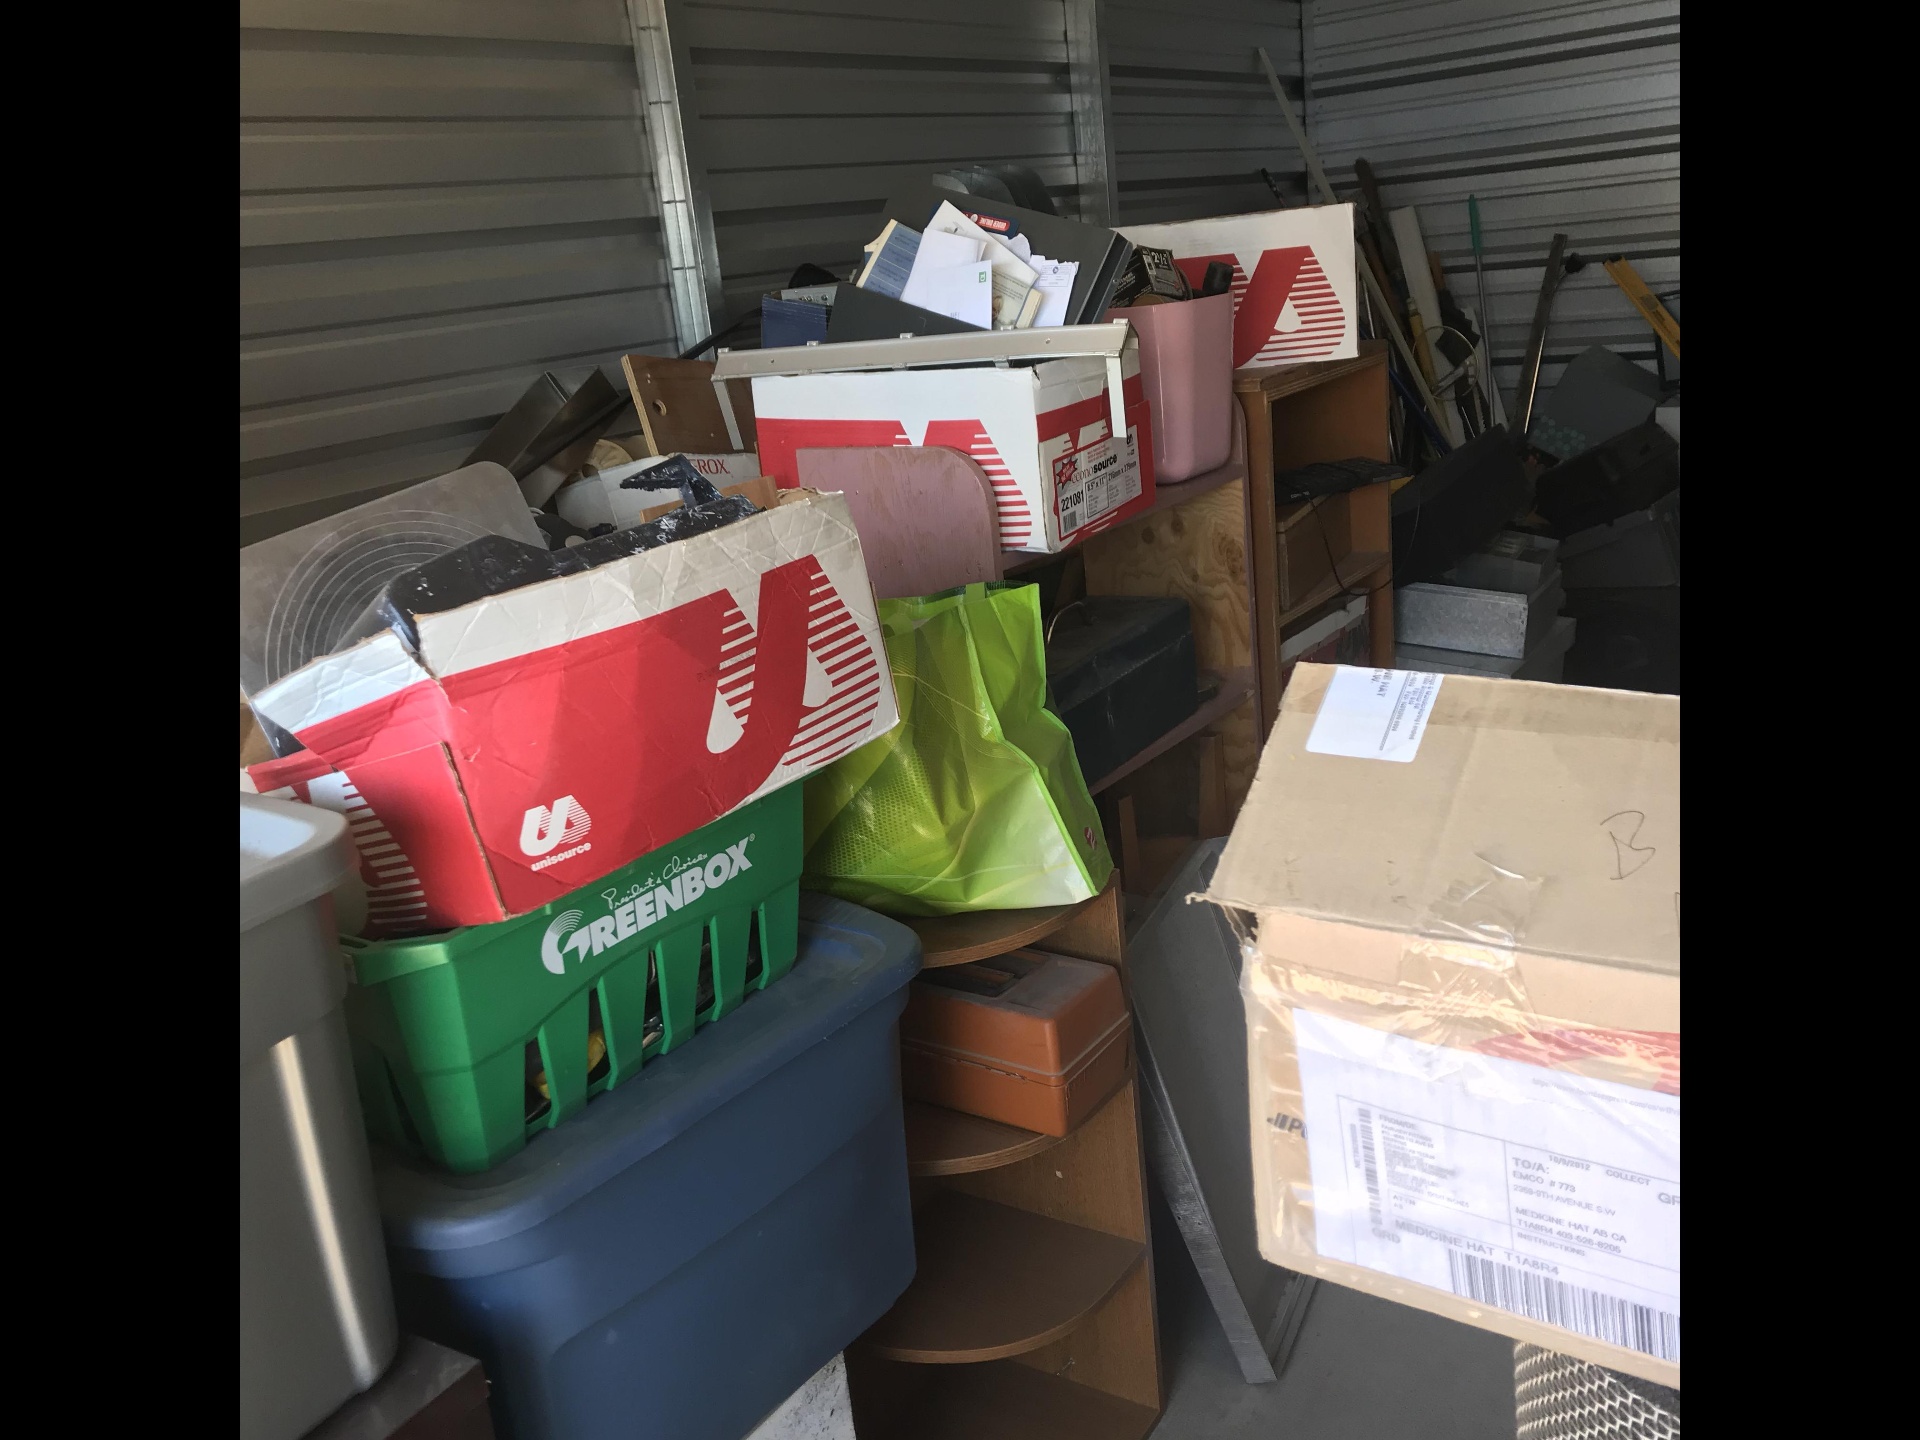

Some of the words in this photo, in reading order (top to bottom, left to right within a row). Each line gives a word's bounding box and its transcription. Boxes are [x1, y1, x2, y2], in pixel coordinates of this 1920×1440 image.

[530, 840, 592, 873] unisource
[541, 834, 756, 975] GREENBOX
[1511, 1156, 1550, 1175] TO/A:
[1512, 1170, 1545, 1185] EMCO
[1558, 1181, 1577, 1194] 773
[1605, 1169, 1652, 1187] COLLECT
[1554, 1194, 1594, 1212] AVENUE
[1371, 1226, 1402, 1245] GRD
[1515, 1206, 1565, 1227] MEDICINE
[1567, 1220, 1590, 1233] HAT
[1593, 1227, 1613, 1238] AB
[1611, 1231, 1628, 1244] CA
[1395, 1219, 1464, 1248] MEDICINE
[1466, 1240, 1495, 1257] HAT
[1504, 1250, 1560, 1276] T1A8R4
